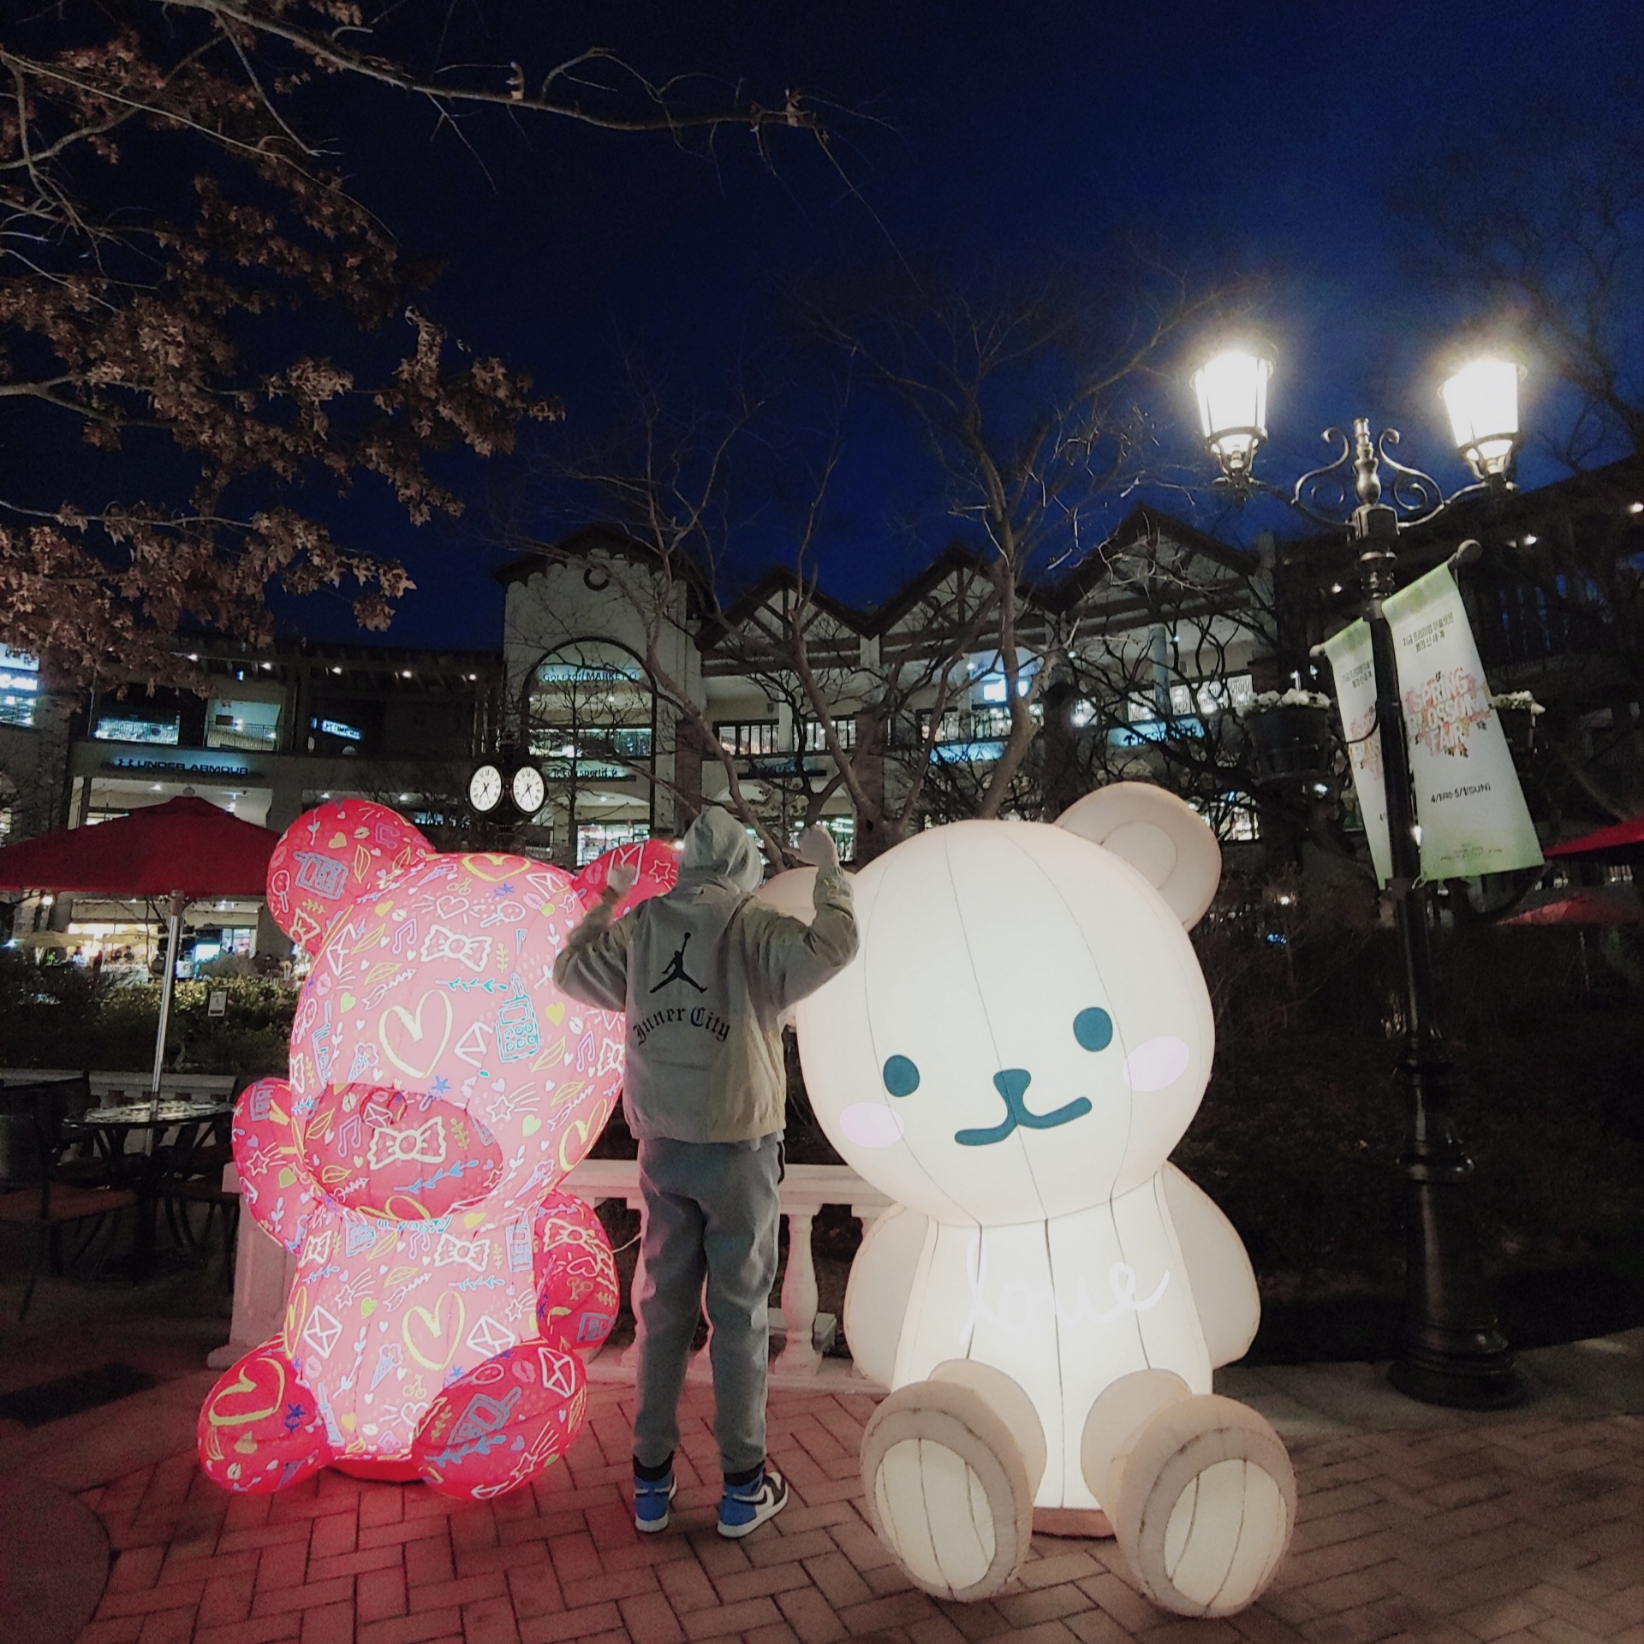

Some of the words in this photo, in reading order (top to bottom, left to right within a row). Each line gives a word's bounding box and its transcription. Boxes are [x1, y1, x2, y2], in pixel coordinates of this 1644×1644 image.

[1407, 668, 1469, 713] SPRING
[1406, 690, 1490, 738] BLOSSOM
[1427, 721, 1465, 756] FAIR
[137, 760, 185, 770] UNDER
[190, 764, 249, 775] ARMOUR
[633, 1007, 686, 1046] Inner
[690, 1006, 731, 1042] City
[958, 1232, 1171, 1346] love
